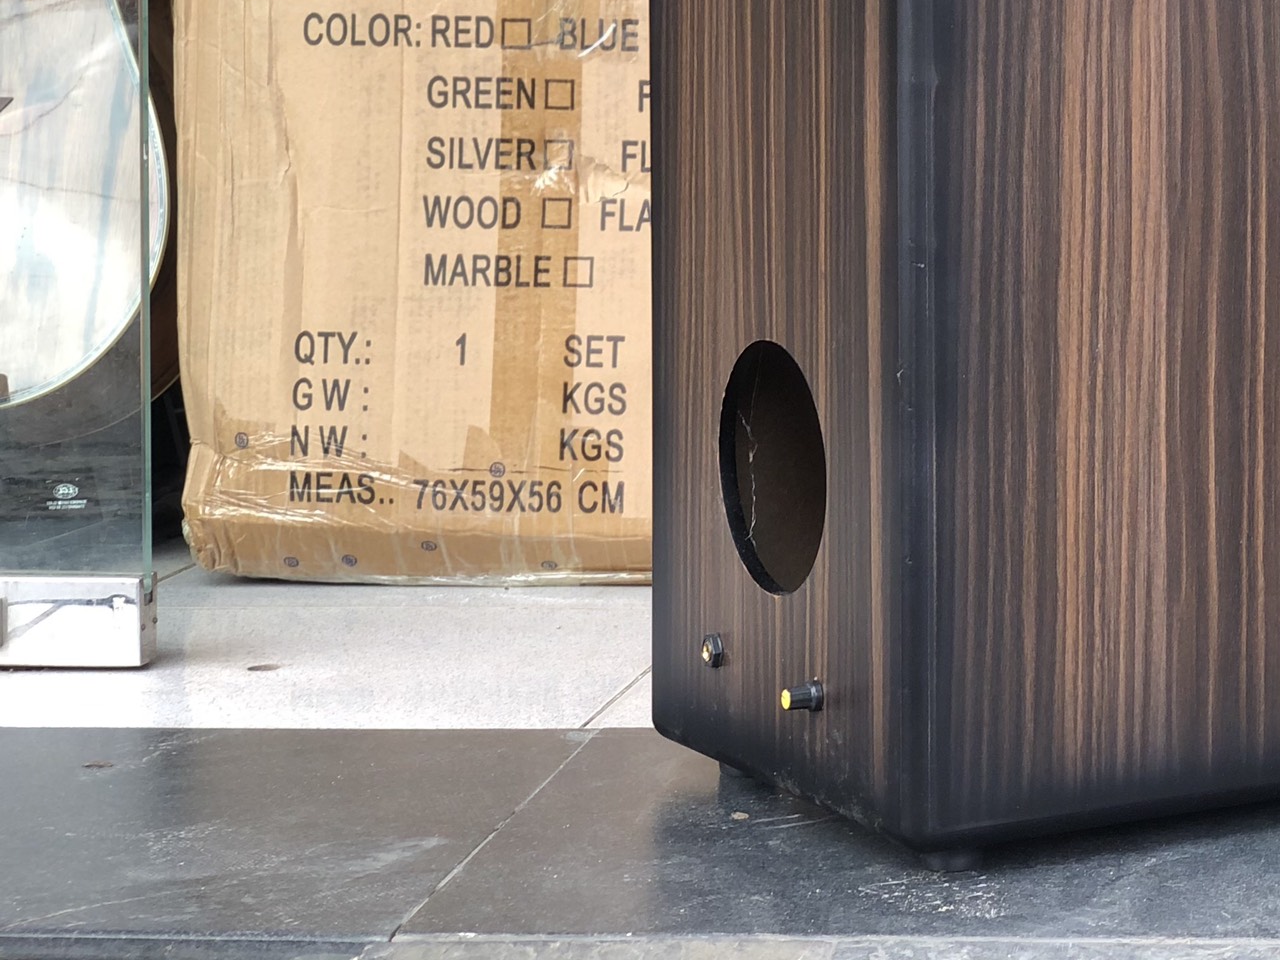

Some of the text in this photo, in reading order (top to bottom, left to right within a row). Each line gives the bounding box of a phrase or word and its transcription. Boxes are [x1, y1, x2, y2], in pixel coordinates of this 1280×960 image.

[303, 12, 640, 53] COLOR: RED BLUE
[426, 75, 537, 111] GREEN
[425, 136, 537, 172] SILVER
[422, 195, 522, 230] WOOD
[423, 253, 552, 288] MARBLE
[455, 332, 468, 367] 1
[563, 334, 626, 369] SET
[562, 381, 627, 416] KGS
[559, 428, 624, 463] KGS
[414, 479, 563, 514] 76X59X56
[577, 480, 625, 515] CM
